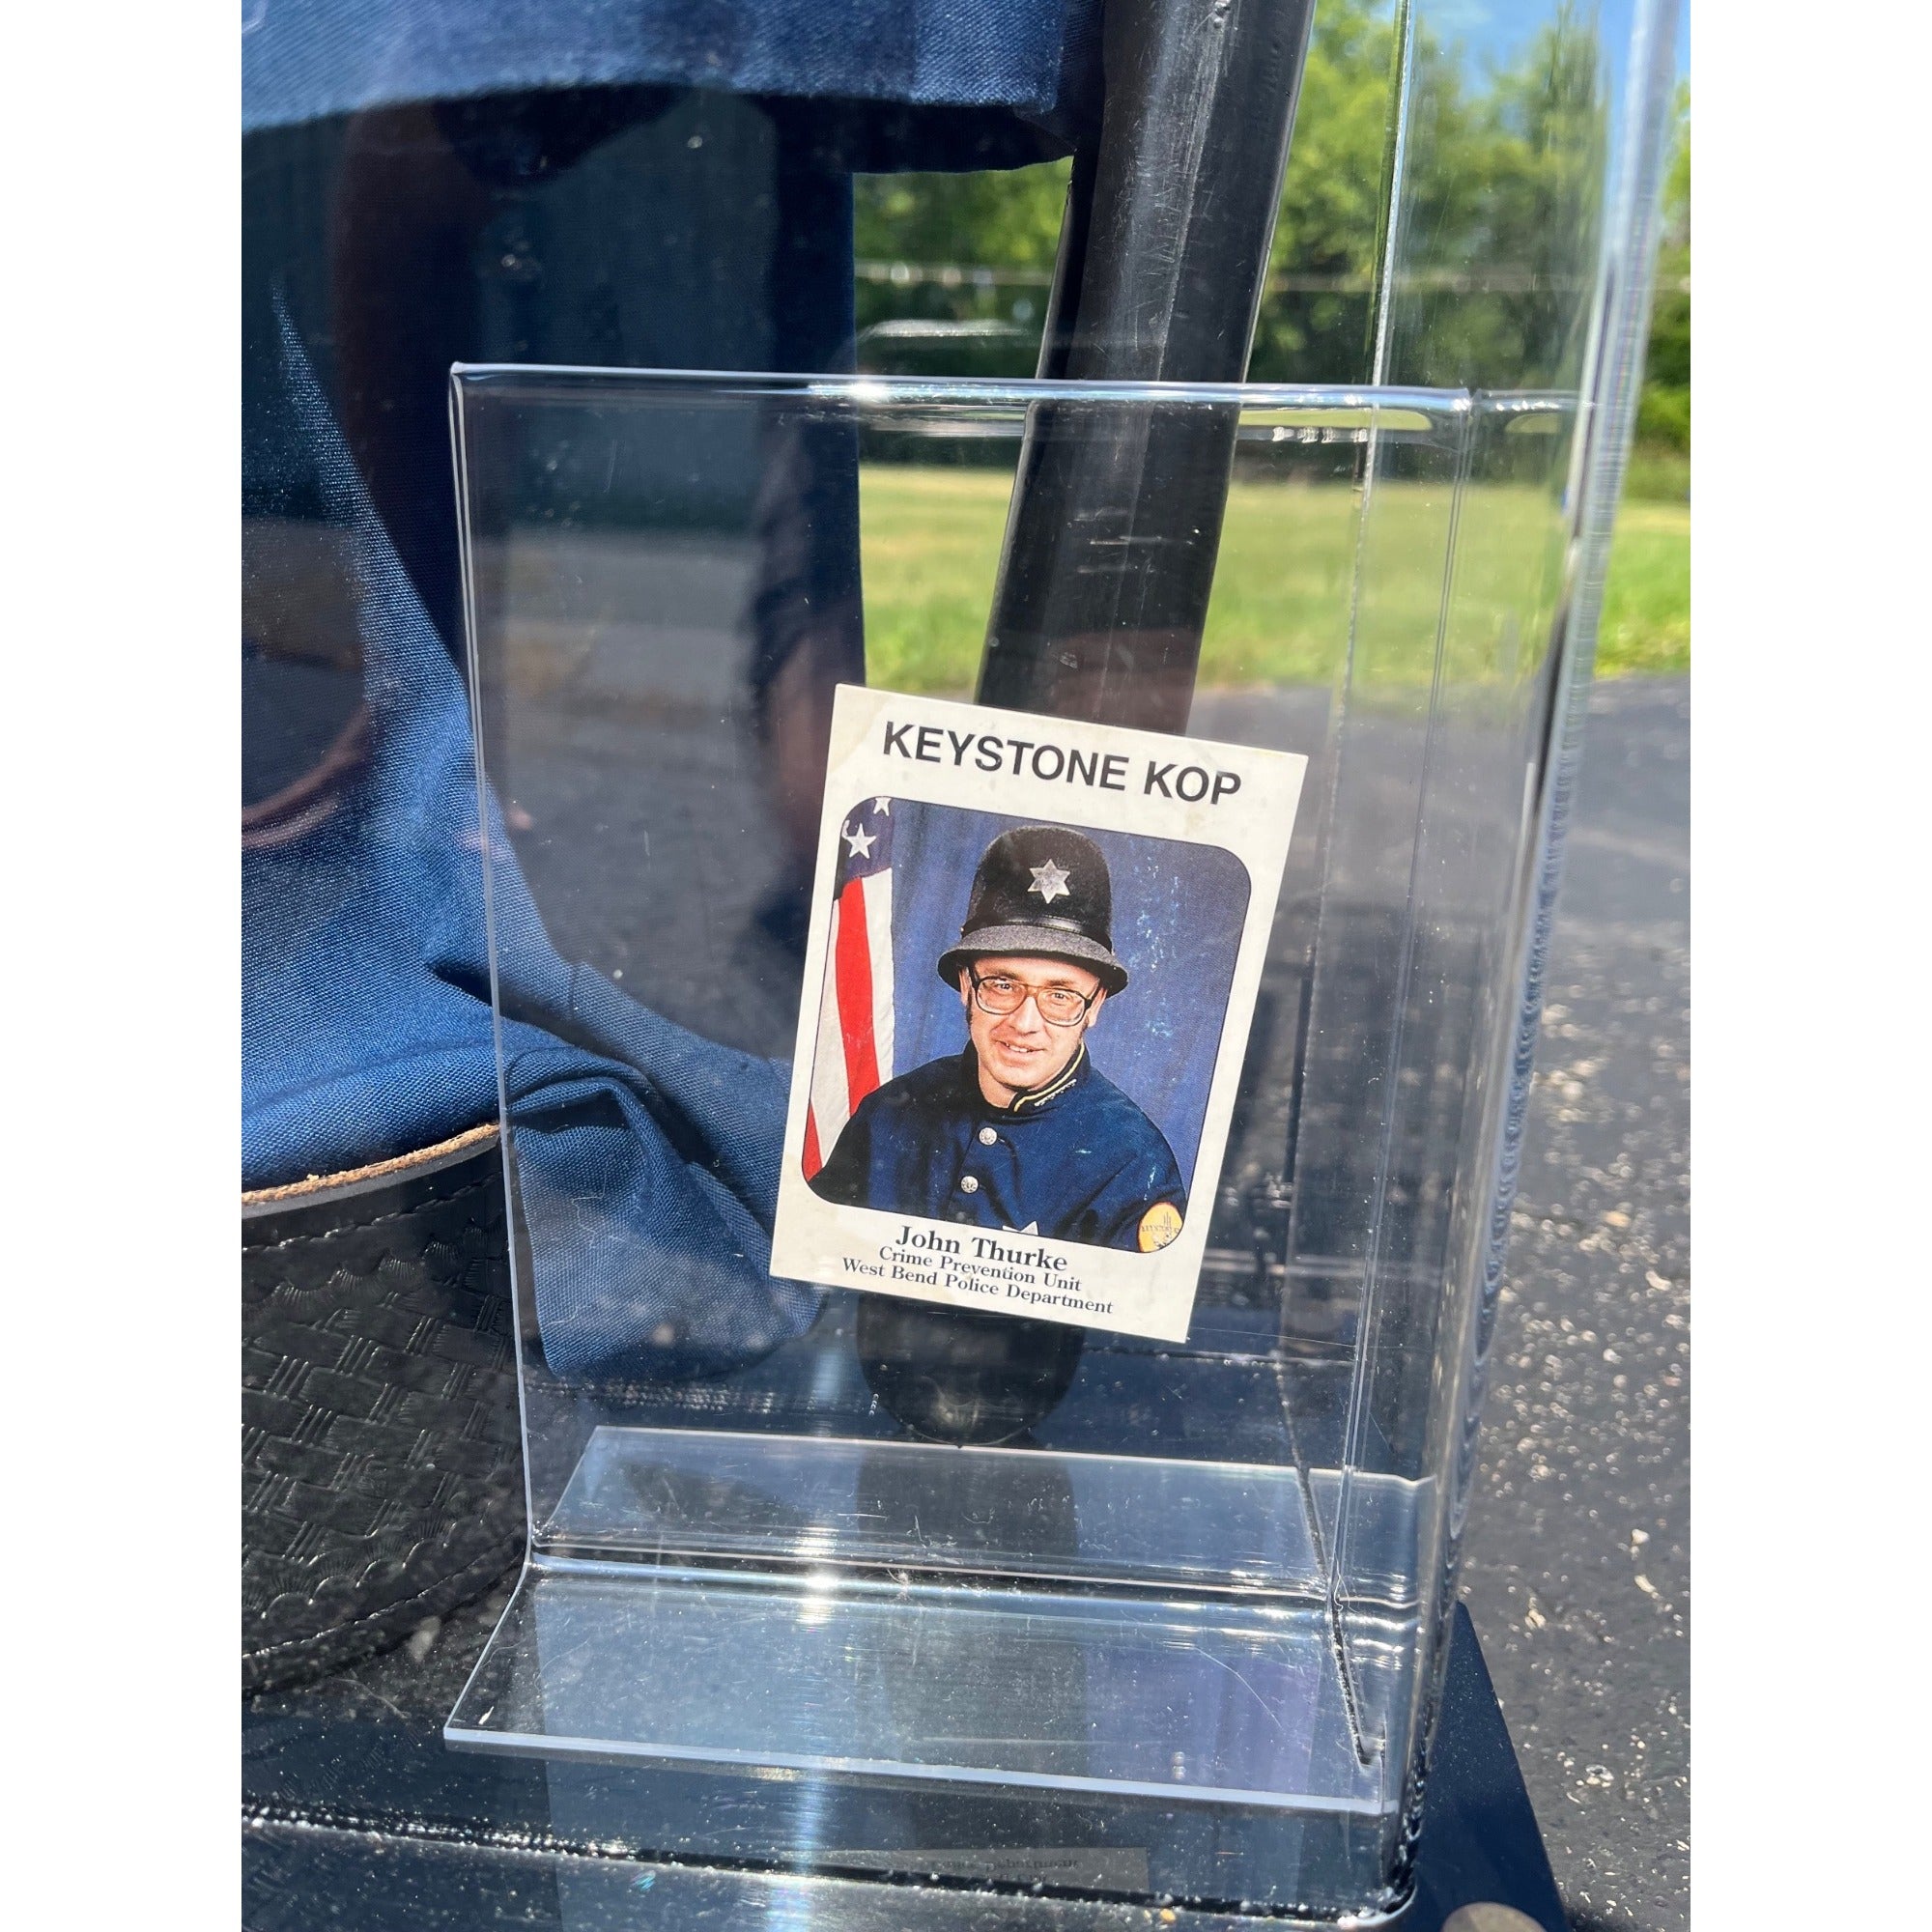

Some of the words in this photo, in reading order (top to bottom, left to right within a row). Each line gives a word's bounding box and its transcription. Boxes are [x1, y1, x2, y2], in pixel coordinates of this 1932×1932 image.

[883, 721, 1129, 791] KEYSTONE
[1143, 760, 1242, 806] KOP
[879, 1245, 933, 1268] Crime
[940, 1255, 1036, 1285] Prevention
[1043, 1273, 1082, 1293] Unit
[895, 1225, 961, 1255] John
[971, 1236, 1068, 1271] Thurke
[842, 1257, 886, 1278] West
[891, 1264, 937, 1286] Bend
[945, 1273, 1000, 1296] Police
[1007, 1284, 1114, 1315] Department
